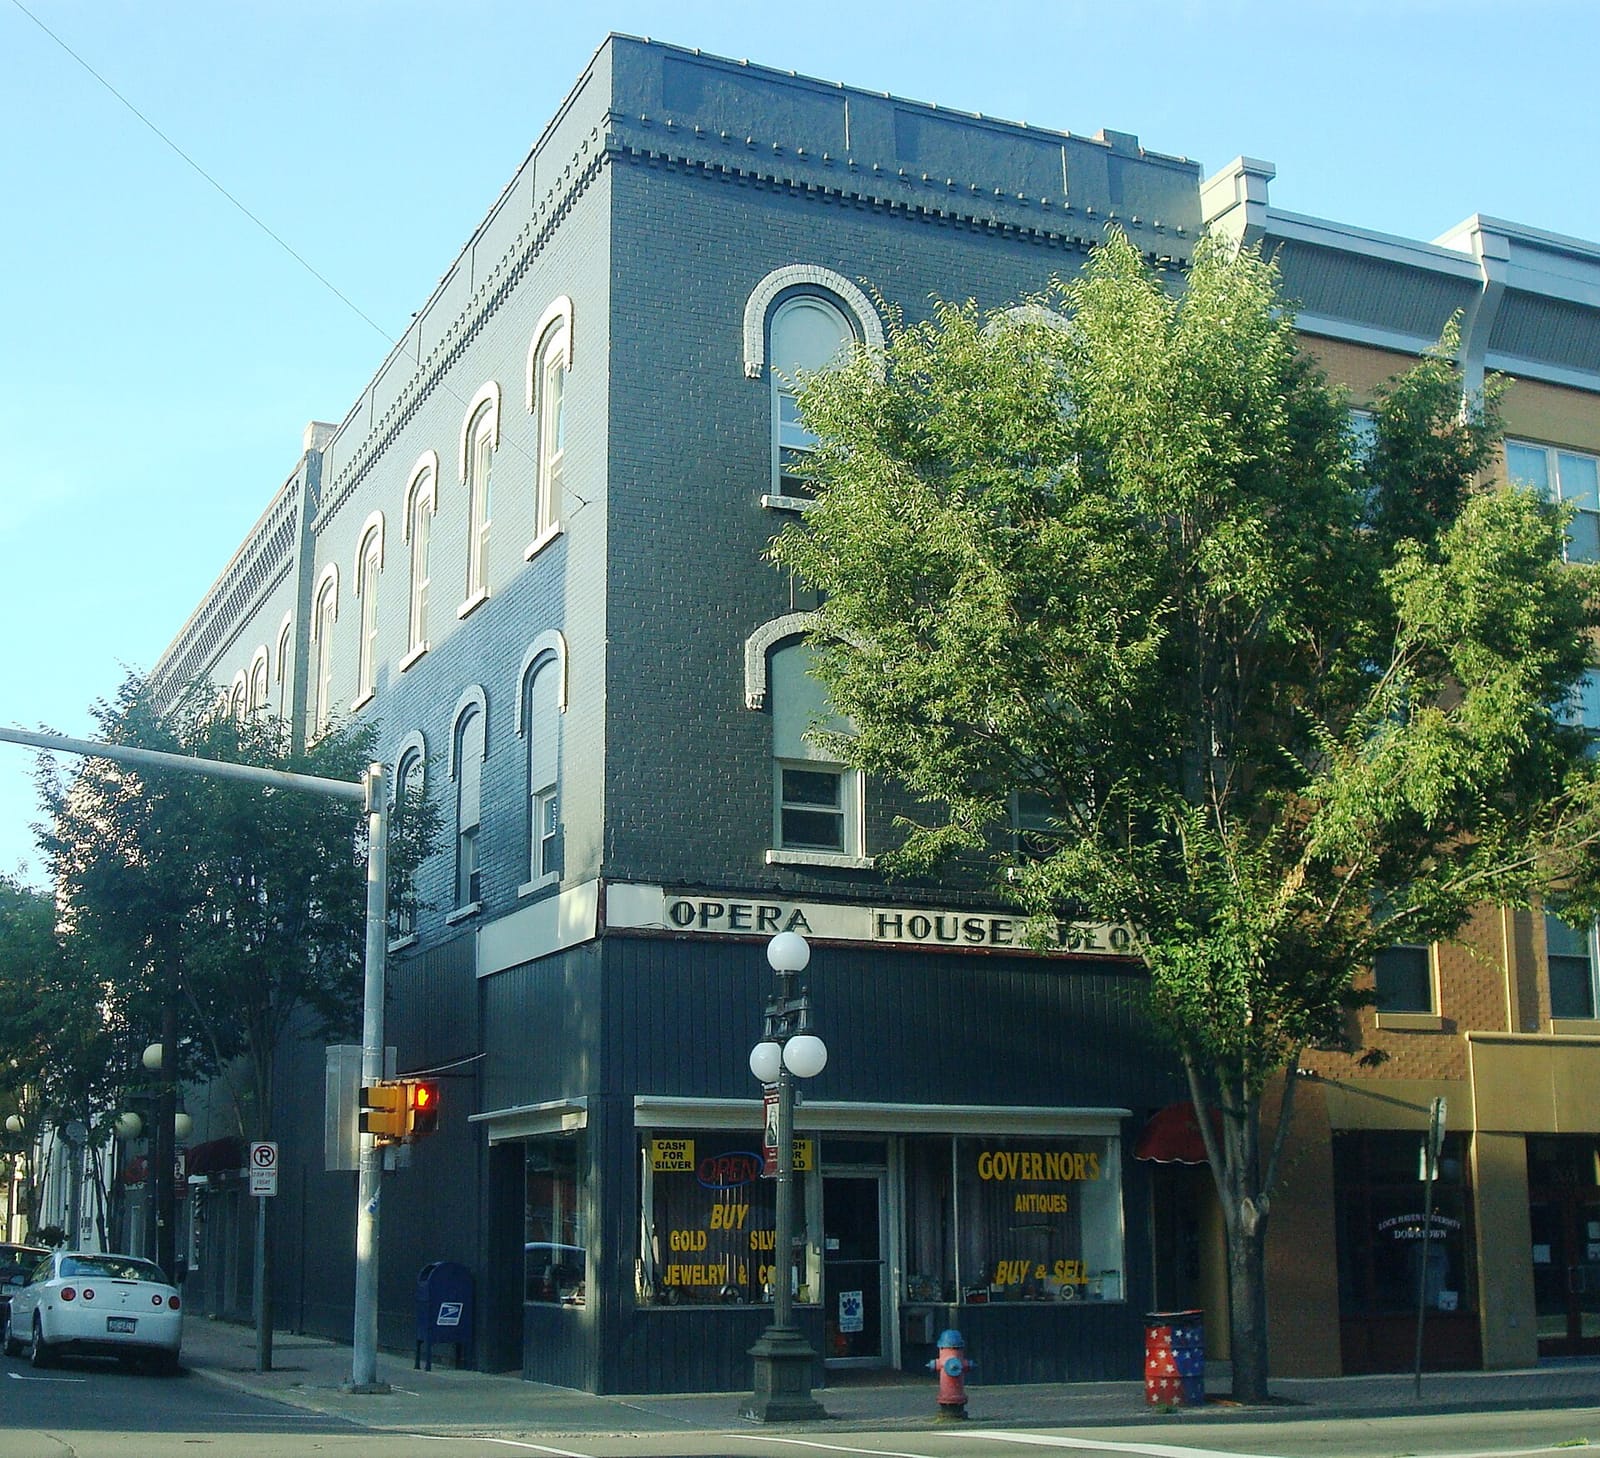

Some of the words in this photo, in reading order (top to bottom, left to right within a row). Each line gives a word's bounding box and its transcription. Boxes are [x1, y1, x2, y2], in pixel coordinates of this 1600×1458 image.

[669, 901, 813, 934] OPERA
[876, 912, 1014, 945] HOUSE
[657, 1141, 686, 1150] CASH
[662, 1151, 684, 1160] FOR
[792, 1141, 806, 1150] SH
[654, 1160, 692, 1169] SILVER
[699, 1158, 758, 1182] OPEN
[978, 1151, 1100, 1180] GOVERNOR'S
[1014, 1194, 1068, 1213] ANTIQUES
[710, 1204, 749, 1230] BUY
[670, 1230, 708, 1252] GOLD
[750, 1230, 776, 1251] SILV
[663, 1264, 727, 1286] JEWELRY
[737, 1264, 748, 1285] &
[994, 1259, 1031, 1286] BUY
[1035, 1264, 1047, 1279] &
[1053, 1259, 1090, 1285] SELL
